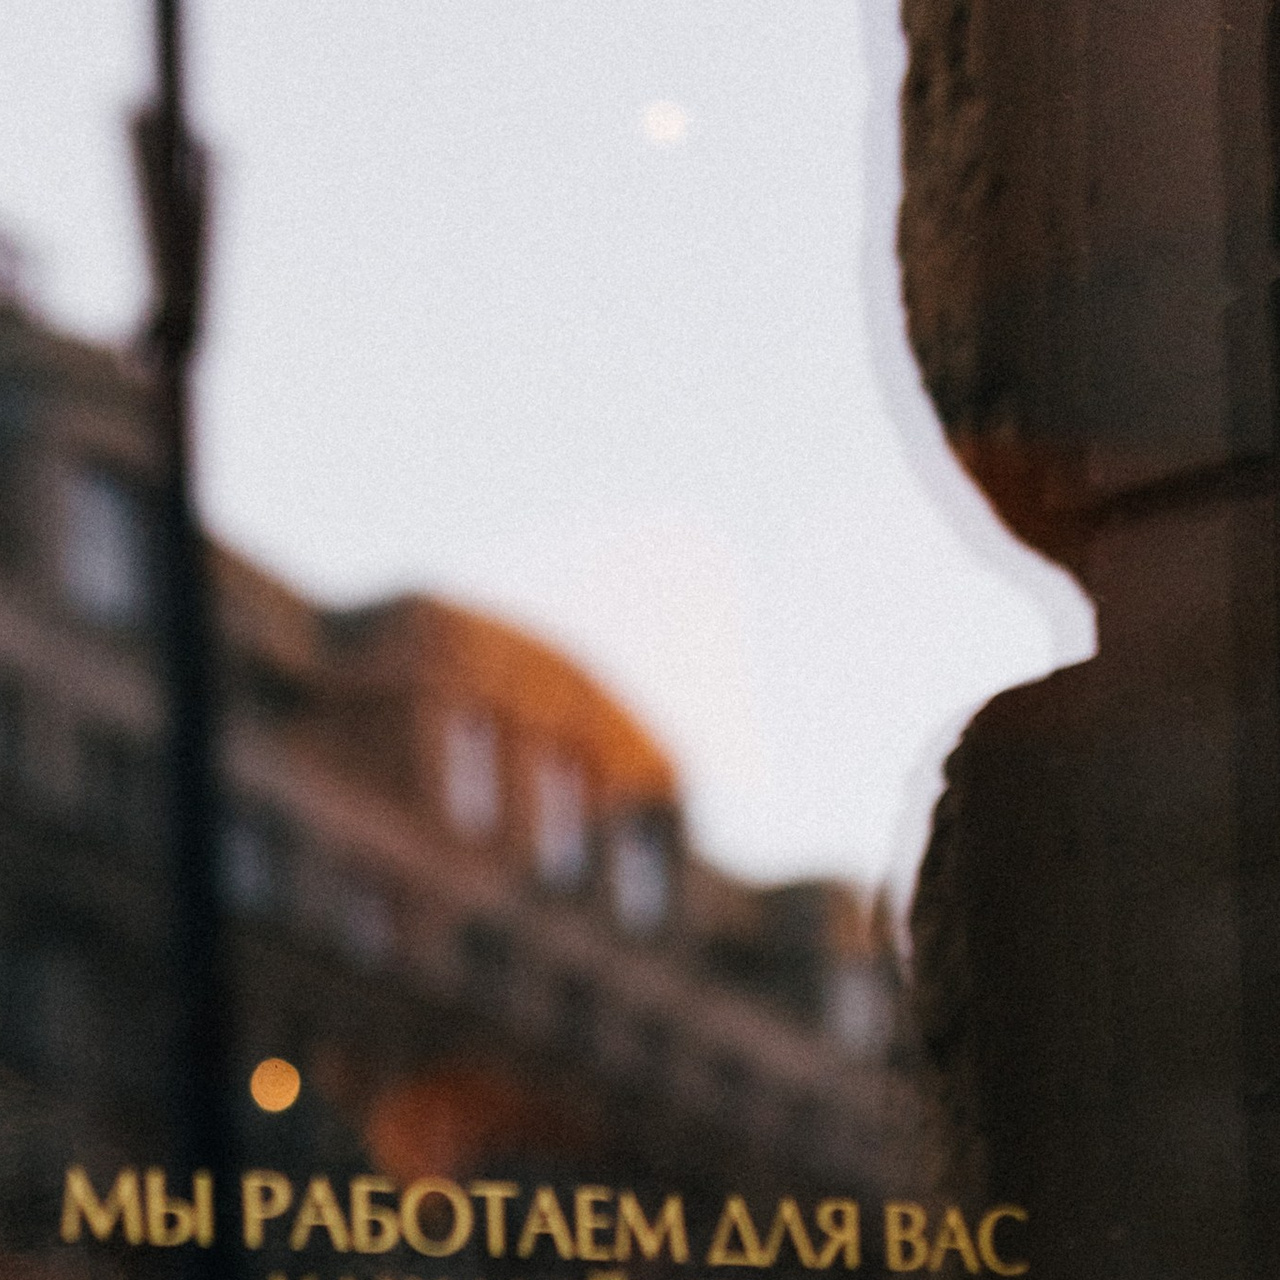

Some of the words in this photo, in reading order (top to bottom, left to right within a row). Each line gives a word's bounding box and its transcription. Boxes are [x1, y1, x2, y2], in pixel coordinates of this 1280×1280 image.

[60, 1167, 215, 1248] МЫ
[241, 1170, 690, 1262] РАБОТАЕМ
[707, 1195, 864, 1270] ДЛЯ
[884, 1203, 1030, 1277] ВАС
